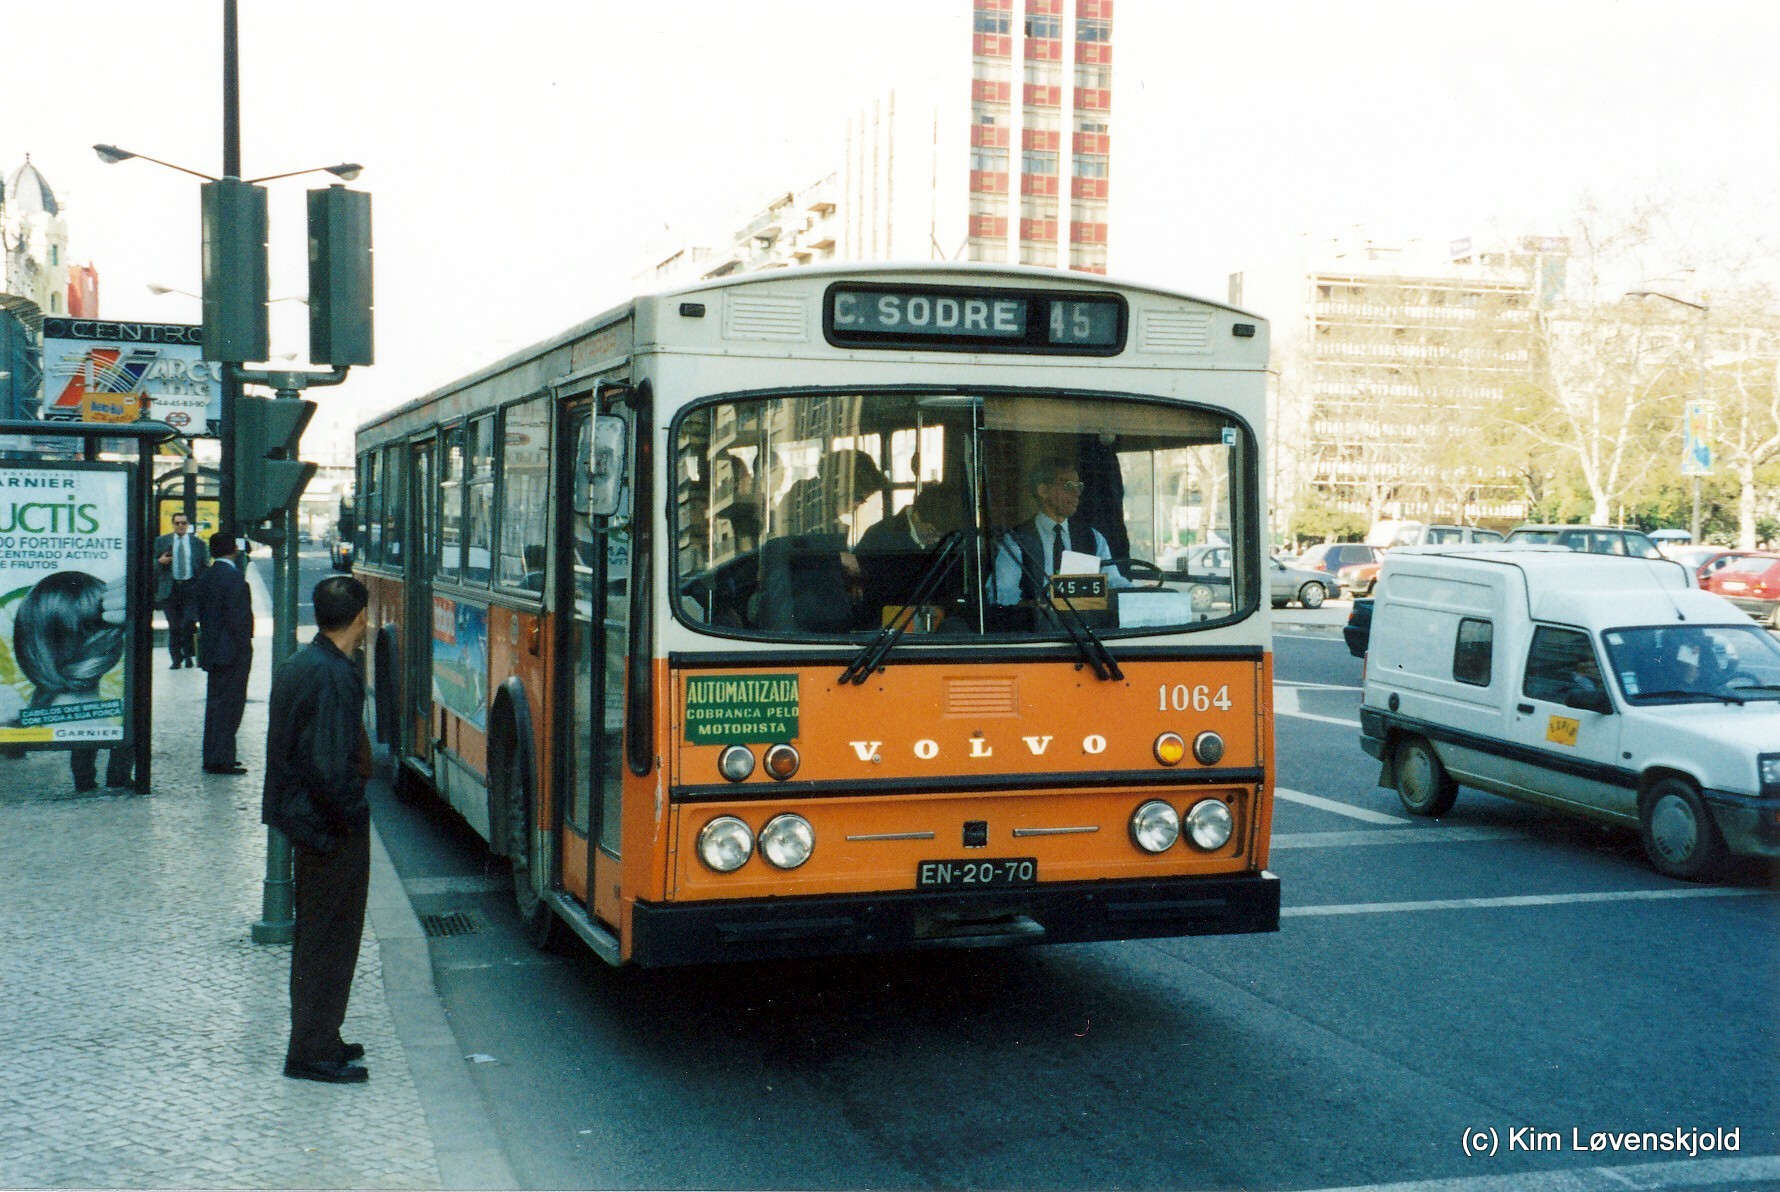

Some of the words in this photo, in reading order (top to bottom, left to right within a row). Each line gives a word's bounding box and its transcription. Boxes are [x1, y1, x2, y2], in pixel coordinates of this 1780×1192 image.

[834, 294, 865, 324] C.
[878, 296, 1018, 331] SODRE
[1050, 302, 1090, 338] 45
[0, 477, 75, 488] RNIER
[20, 537, 122, 549] FORTIFICANTE
[66, 551, 108, 559] ACTIVO
[11, 561, 58, 569] FRUTOS
[687, 680, 799, 704] AUTOMATIZADA
[1159, 684, 1232, 711] 1064
[22, 706, 62, 718] CABELOS
[63, 705, 82, 713] QUE
[767, 706, 799, 717] PELO
[56, 729, 119, 738] GARNIER
[698, 723, 786, 735] MOTORISTA
[849, 734, 1107, 761] VOLVO
[921, 861, 1033, 884] EN-20-70
